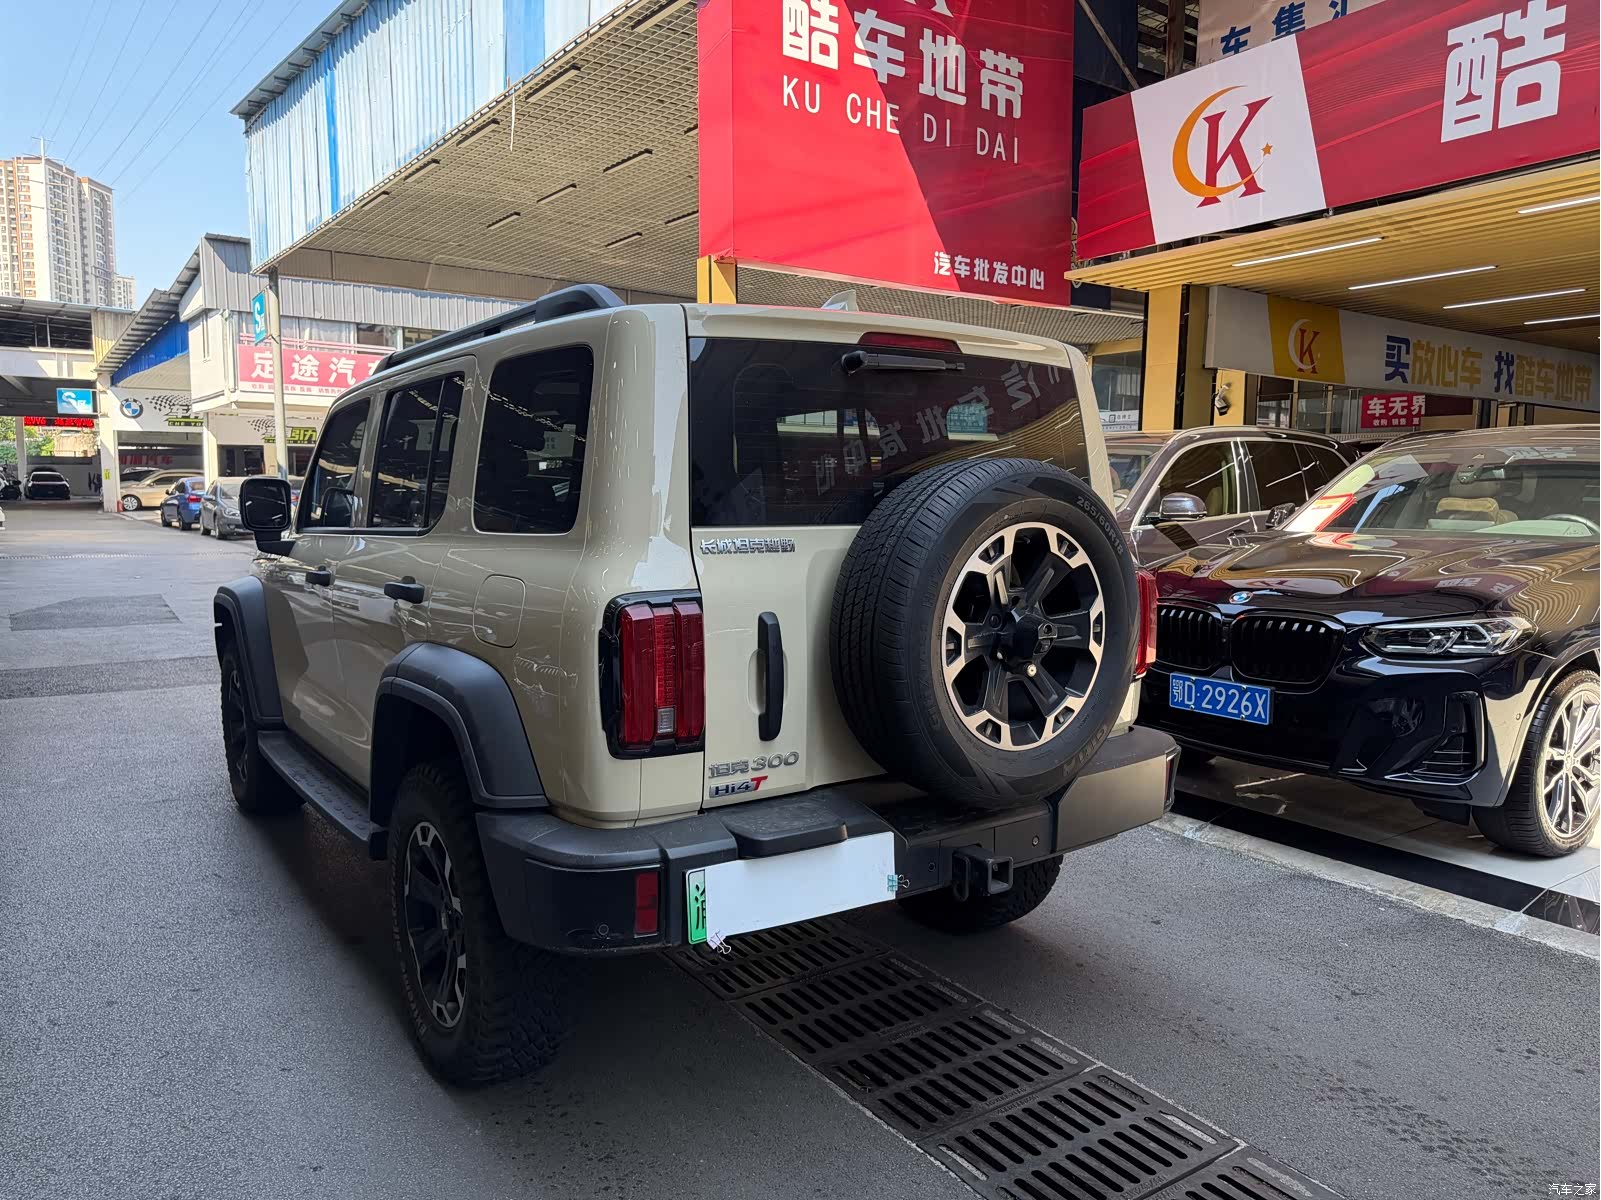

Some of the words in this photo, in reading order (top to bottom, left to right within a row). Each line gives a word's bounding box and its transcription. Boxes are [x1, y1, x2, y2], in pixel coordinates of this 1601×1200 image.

[782, 0, 1024, 118] 酷车地带
[1441, 0, 1567, 143] 酷
[783, 75, 821, 113] KU
[846, 92, 900, 134] CHE
[923, 113, 950, 147] DI
[977, 128, 1018, 164] DAI
[933, 250, 1045, 290] 汽车批发中心
[251, 351, 377, 385] 定途汽
[1384, 334, 1483, 390] 买放心车
[1494, 350, 1592, 403] 找酷车地带
[700, 537, 796, 554] 长城坦克越野
[1076, 495, 1124, 555] 265/60R18
